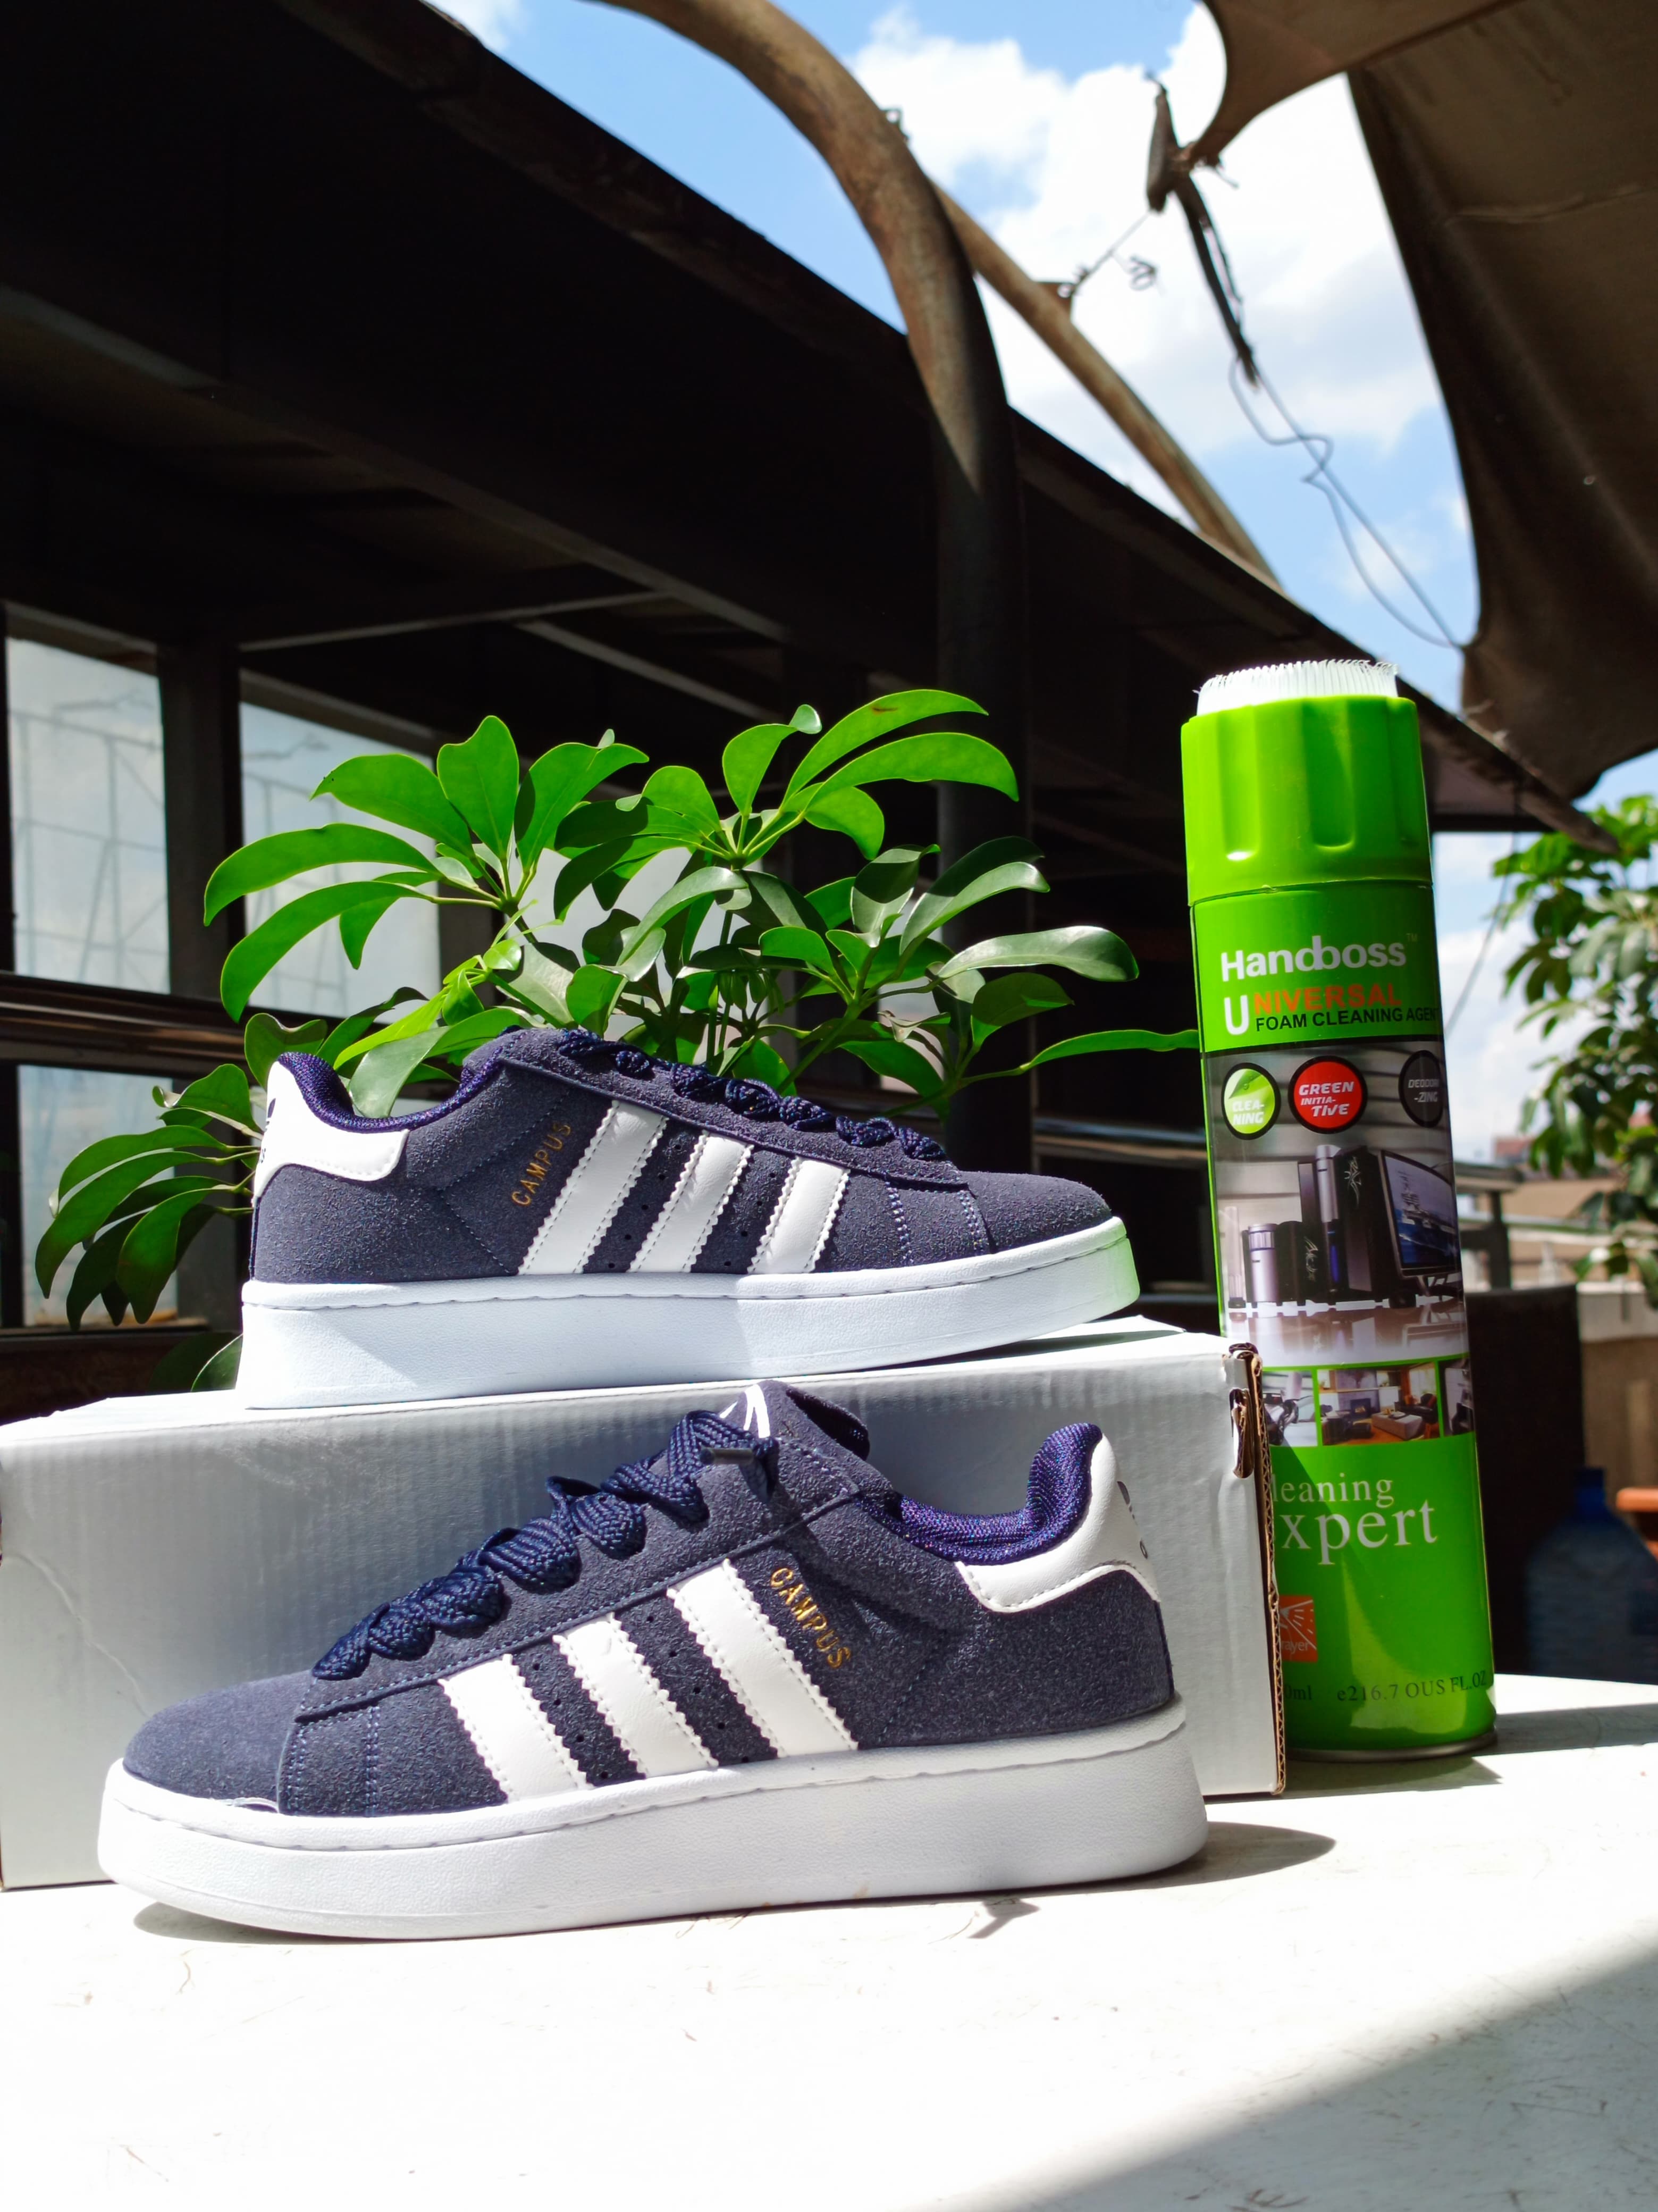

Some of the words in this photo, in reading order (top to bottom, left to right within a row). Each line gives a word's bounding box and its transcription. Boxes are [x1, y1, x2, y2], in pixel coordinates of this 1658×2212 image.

[1221, 936, 1407, 982] Handboss
[1256, 1013, 1307, 1032] FOAM
[1312, 1007, 1403, 1027] CLEANING
[1299, 1081, 1354, 1095] GREEN
[1232, 1100, 1265, 1112] CLEA-
[1300, 1096, 1335, 1105] INITIA-
[1311, 1103, 1350, 1117] TIVE
[1232, 1112, 1264, 1125] NING
[511, 1121, 571, 1206] CAMPUS
[1270, 1472, 1394, 1508] leaning
[1280, 1499, 1438, 1565] xpert
[771, 1568, 851, 1669] CAMPUS
[1282, 1640, 1309, 1655] rayer
